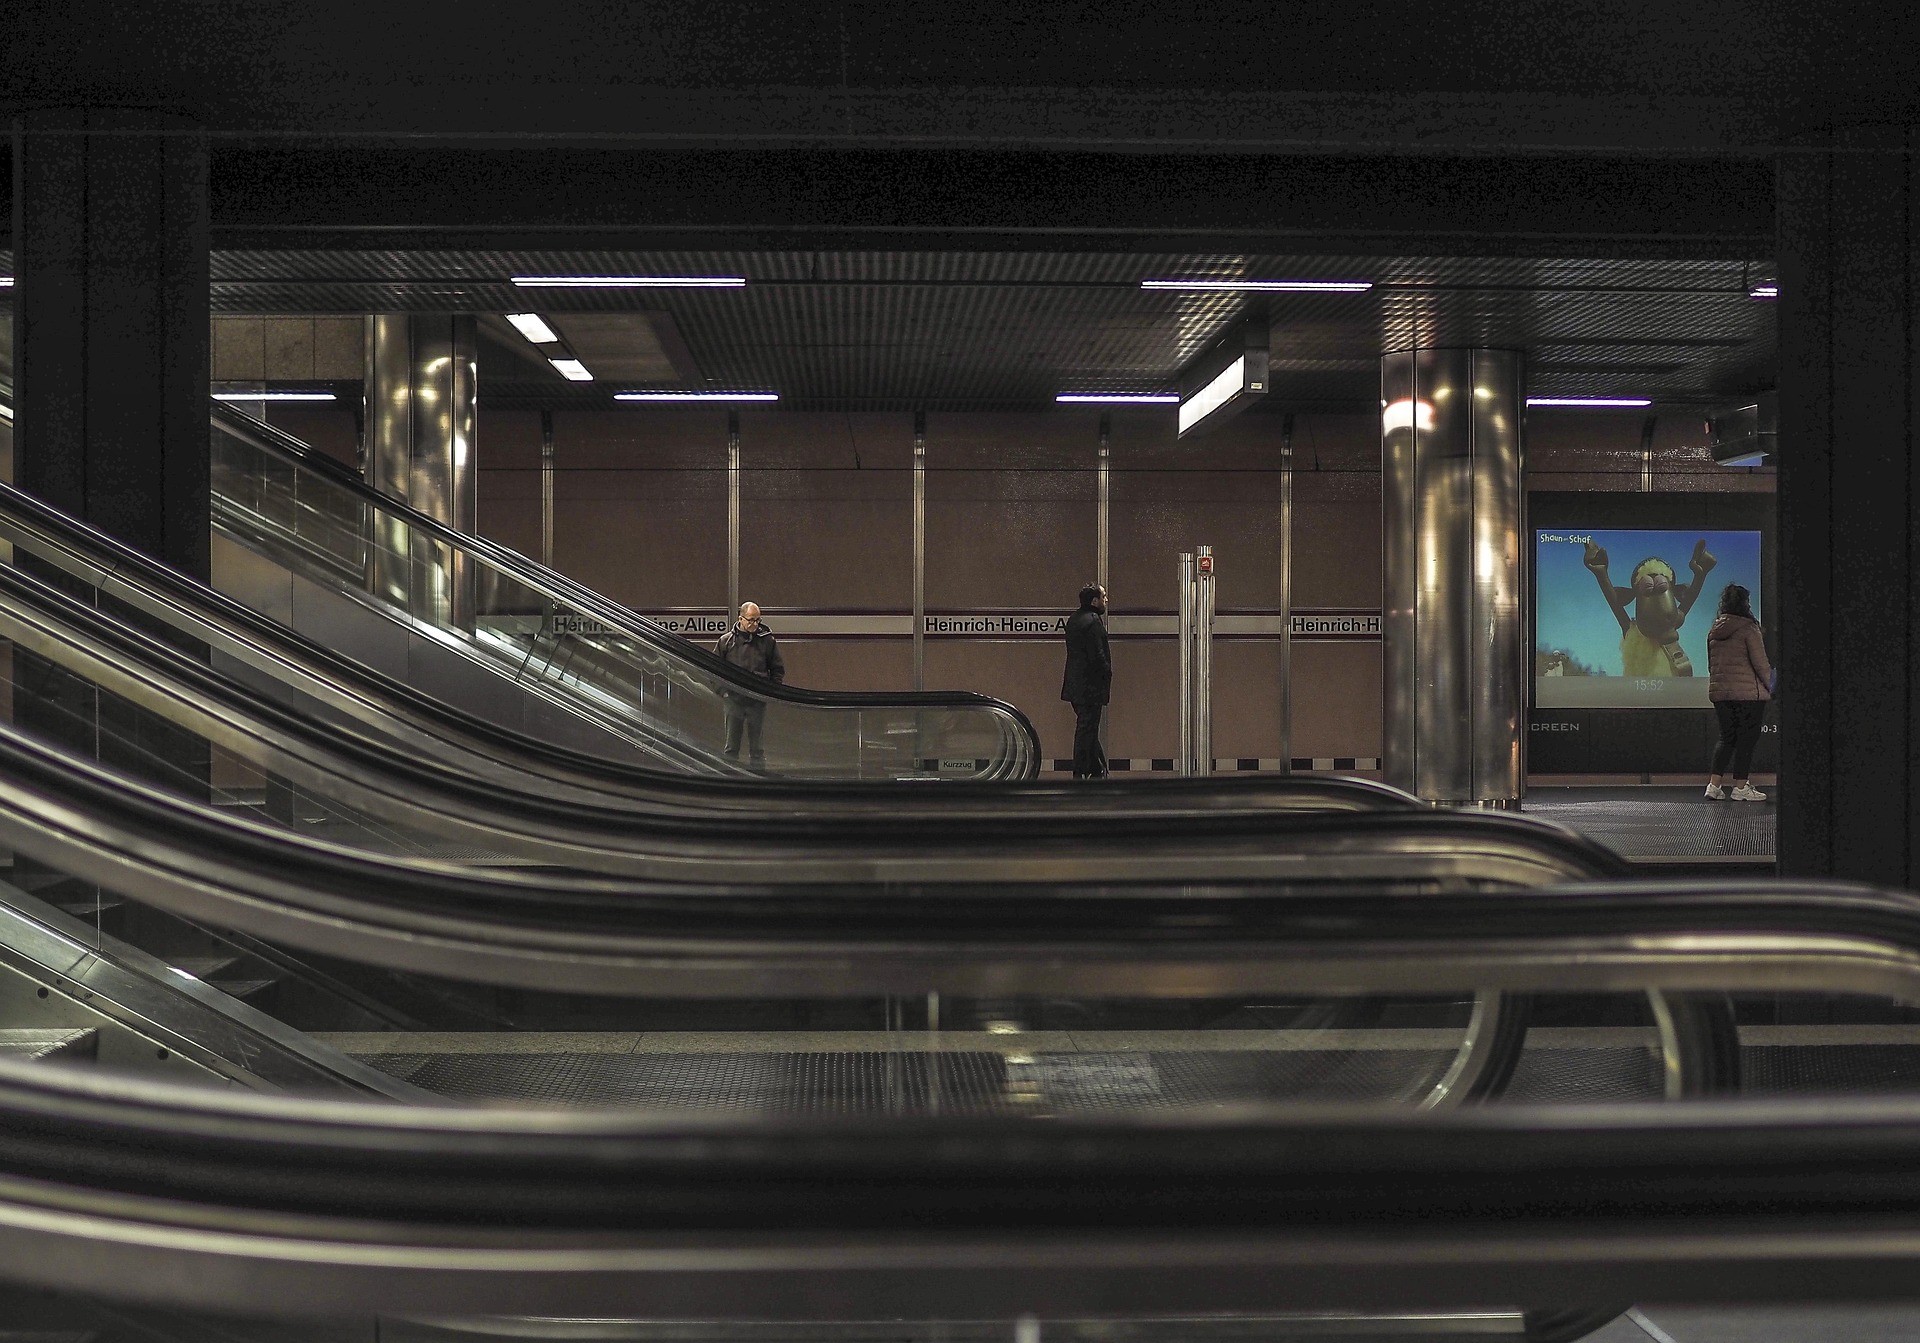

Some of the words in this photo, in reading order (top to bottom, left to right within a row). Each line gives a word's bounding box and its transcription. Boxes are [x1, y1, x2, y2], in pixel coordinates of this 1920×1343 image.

[1540, 533, 1563, 543] Shaun
[1569, 534, 1592, 545] Schaf
[1292, 617, 1382, 632] Heinrich-H
[1634, 679, 1664, 691] 15:52
[1527, 723, 1580, 731] CREEN
[943, 761, 972, 769] Kurzzug
